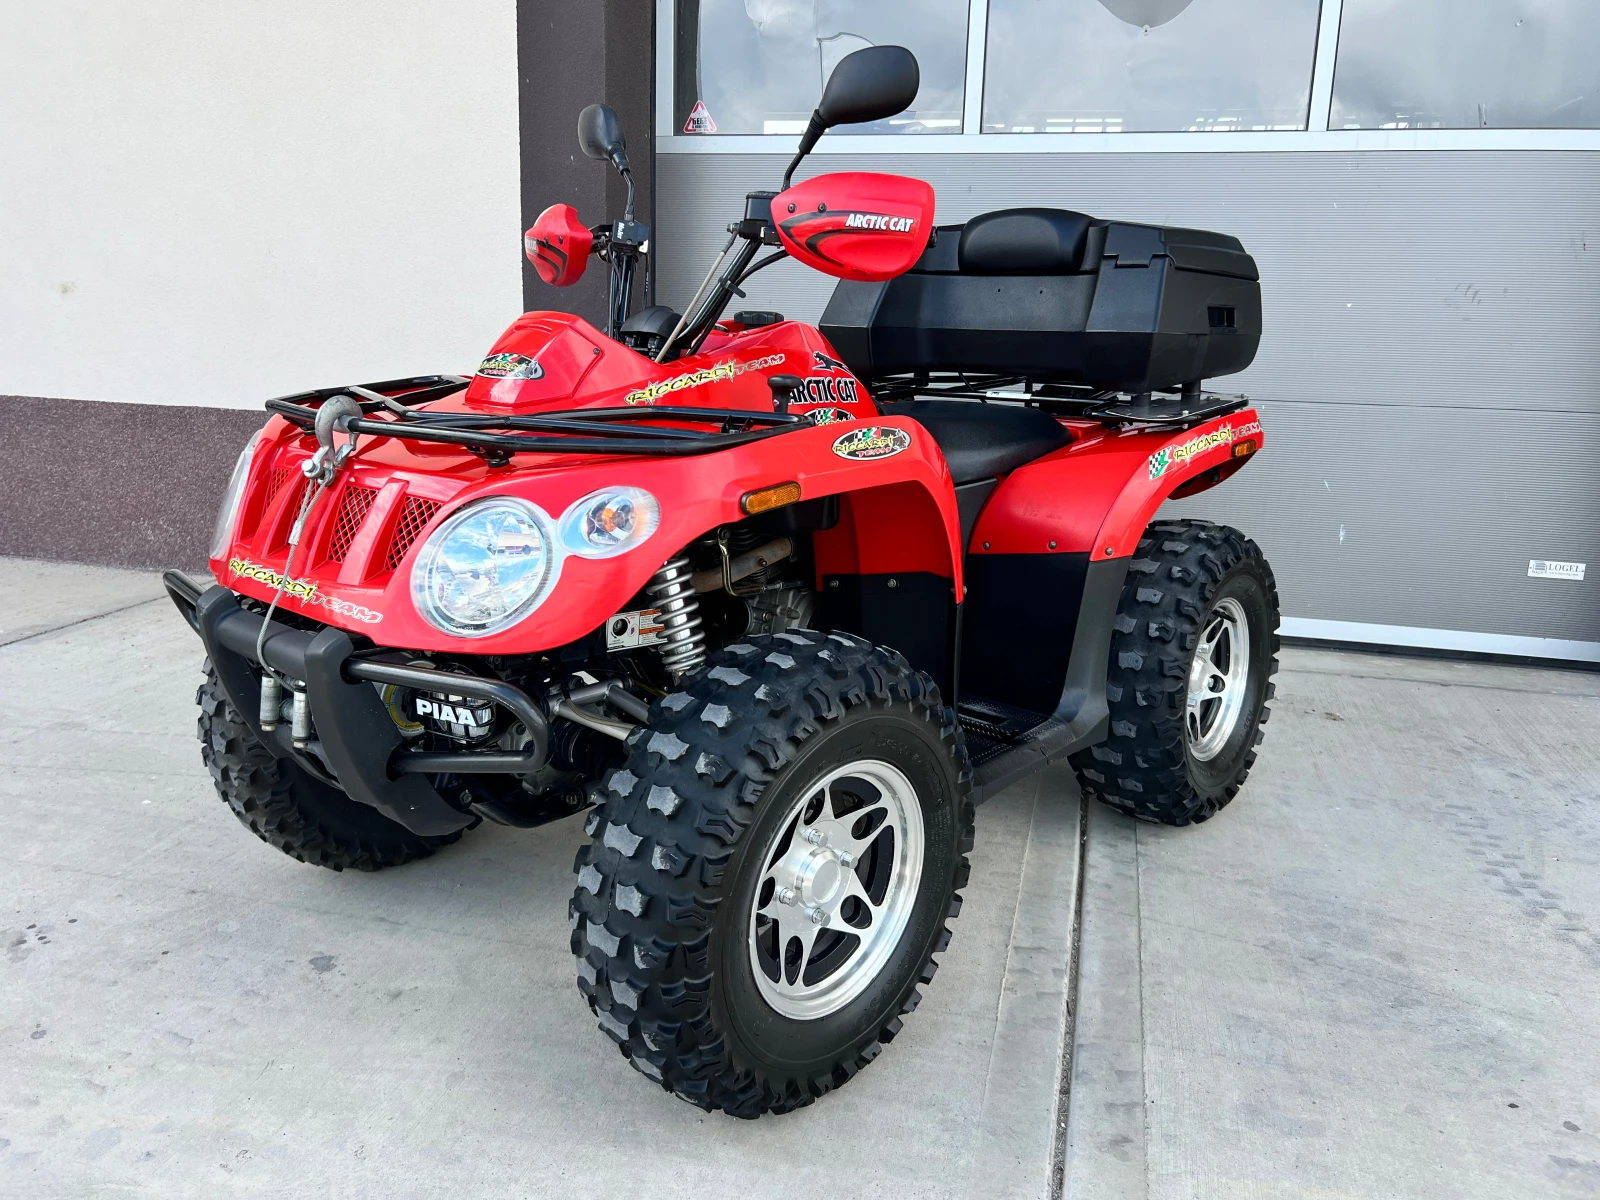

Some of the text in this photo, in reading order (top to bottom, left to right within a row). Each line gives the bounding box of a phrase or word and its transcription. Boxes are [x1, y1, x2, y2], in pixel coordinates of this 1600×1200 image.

[845, 213, 914, 232] ARCTIC CAT
[625, 354, 785, 402] RICCARDI TEAM
[836, 377, 859, 403] CAT
[833, 435, 894, 454] RICCARDI
[1173, 422, 1261, 461] RICCARDI TEAM
[229, 558, 383, 624] RICCARDI TEAM
[415, 698, 477, 727] PIAA
